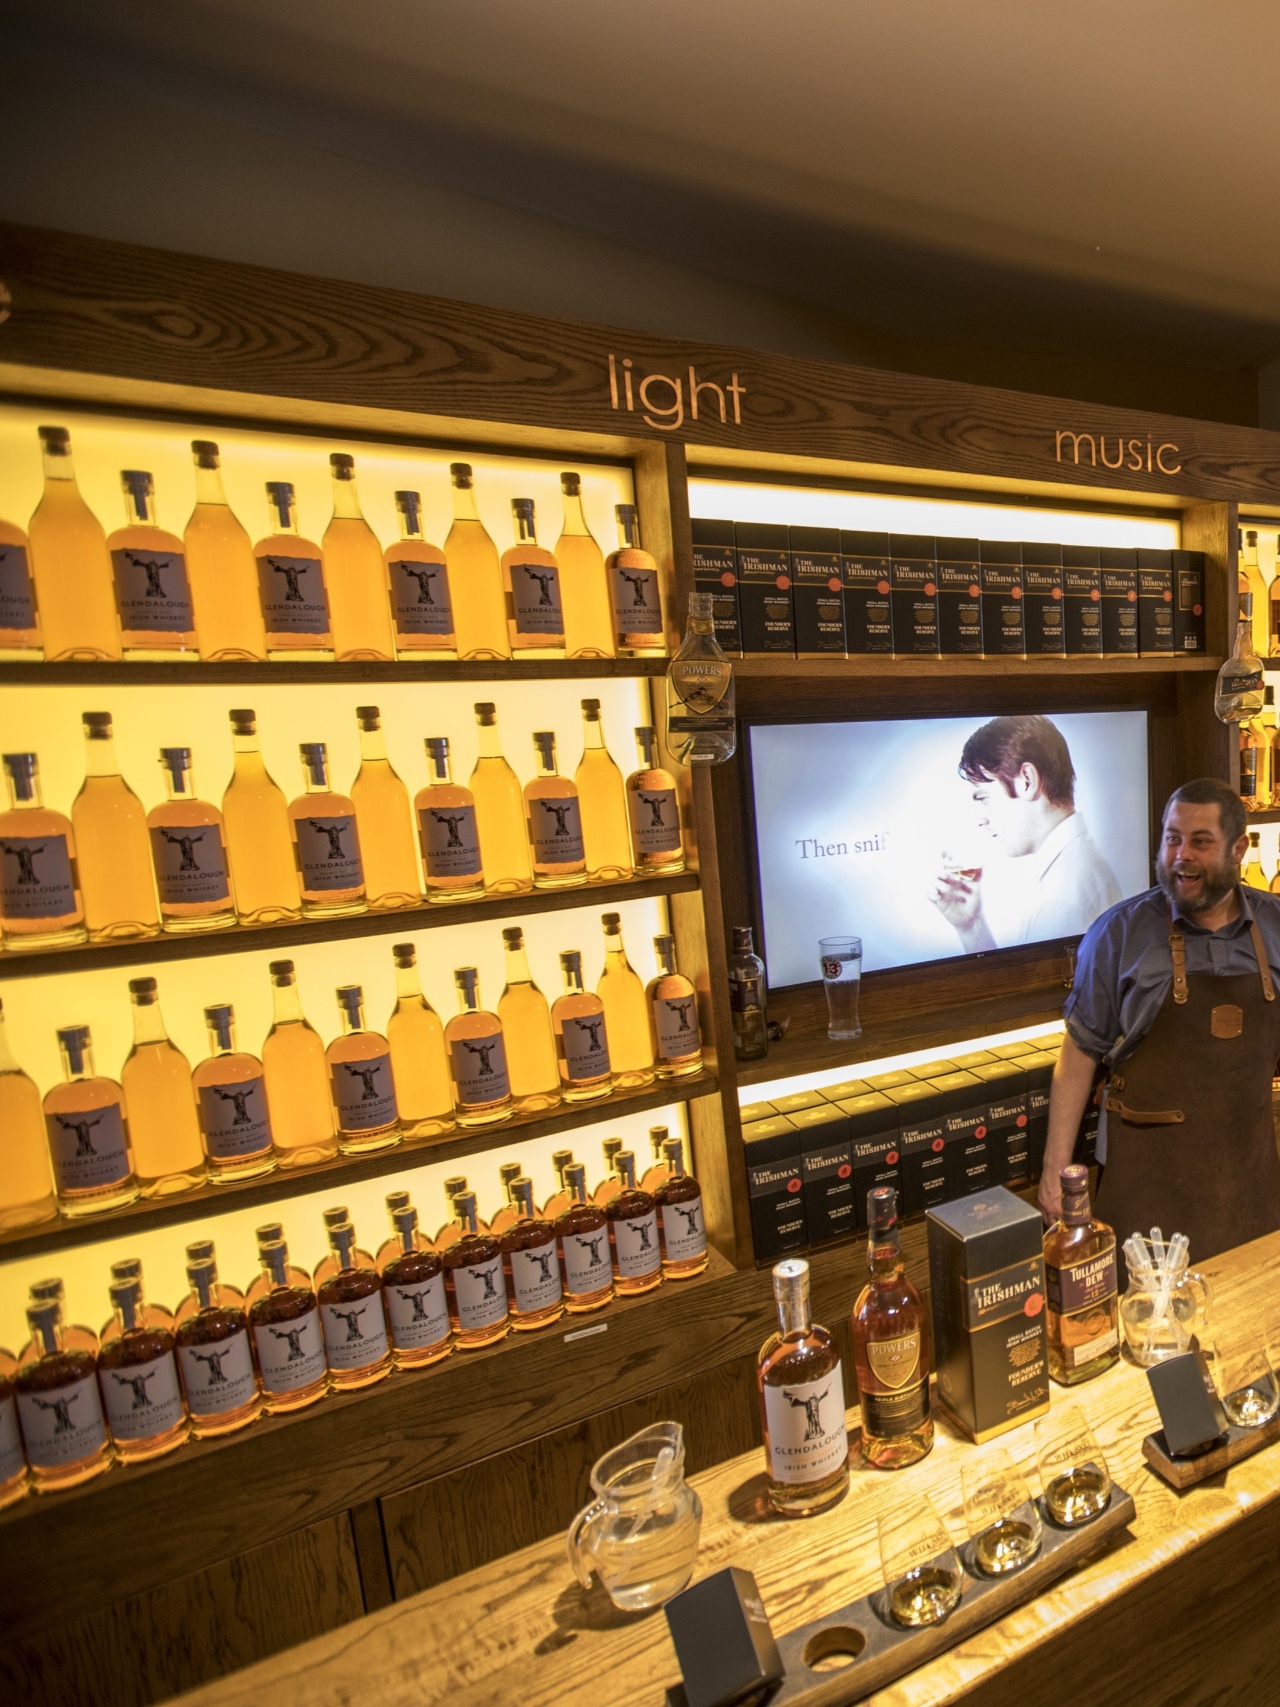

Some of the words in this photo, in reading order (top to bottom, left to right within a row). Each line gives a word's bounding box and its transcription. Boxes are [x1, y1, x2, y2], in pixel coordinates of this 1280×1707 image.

[608, 353, 746, 431] light
[1055, 430, 1182, 475] music
[743, 562, 787, 571] IRISHMAN
[797, 564, 839, 573] IRISHMAN
[848, 567, 888, 576] IRISHMAN
[896, 570, 934, 579] IRISHMAN
[942, 572, 978, 581] IRISHMAN
[986, 575, 1020, 583] IRISHMAN
[1027, 576, 1060, 584] IRISHMAN
[265, 603, 326, 612] GLENDALOUGH
[397, 605, 450, 614] GLENDALOUG
[518, 606, 562, 615] GLENDALOU
[616, 607, 660, 616] GLENDALOUG
[682, 665, 722, 676] POWERS
[536, 836, 582, 845] GLENDALOUG
[427, 847, 477, 857] GLENDALOUG
[795, 838, 848, 859] Then
[304, 859, 361, 870] GLENDALOUG
[822, 962, 838, 974] 13
[661, 1030, 698, 1042] GLENDALOU
[569, 1049, 607, 1062] GLENDALO
[459, 1071, 507, 1086] GLENDALOUG
[340, 1095, 395, 1111] GLENDALOUG
[994, 1106, 1004, 1114] THE
[991, 1105, 1025, 1119] IRISHMAN
[208, 1120, 268, 1137] GLENDALOUG
[949, 1116, 984, 1131] IRISHMAN
[951, 1117, 962, 1125] THE
[905, 1129, 942, 1144] IRISHMAN
[907, 1129, 919, 1138] THE
[857, 1141, 896, 1157] IRISHMAN
[859, 1142, 871, 1150] THE
[59, 1151, 124, 1167] LENDALOUGH
[808, 1154, 849, 1170] IRISHMAN
[810, 1155, 823, 1164] THE
[755, 1168, 798, 1185] IRISHMAN
[758, 1170, 771, 1179] THE
[668, 1230, 704, 1246] GLENDALO
[620, 1246, 659, 1262] GLENDALO
[569, 1260, 611, 1279] GLENDALOU
[1070, 1253, 1114, 1282] TULLAMORE
[518, 1277, 559, 1296] GLENDALO
[1085, 1271, 1104, 1288] DEW
[977, 1275, 1041, 1309] IRISHMAN
[981, 1282, 1002, 1297] THE
[461, 1293, 507, 1313] GLENDALO
[1006, 1339, 1020, 1348] IRISH
[1020, 1329, 1043, 1343] WHISKEY
[1007, 1331, 1024, 1343] SMALL
[1024, 1324, 1041, 1336] BATCH
[872, 1338, 916, 1356] POWERS
[1008, 1360, 1044, 1382] FOUNDER'S
[1011, 1369, 1042, 1387] RESERVE
[775, 1424, 845, 1455] GLENDALOUGH
[784, 1463, 807, 1472] IRISH
[811, 1446, 842, 1467] WHISKEY
